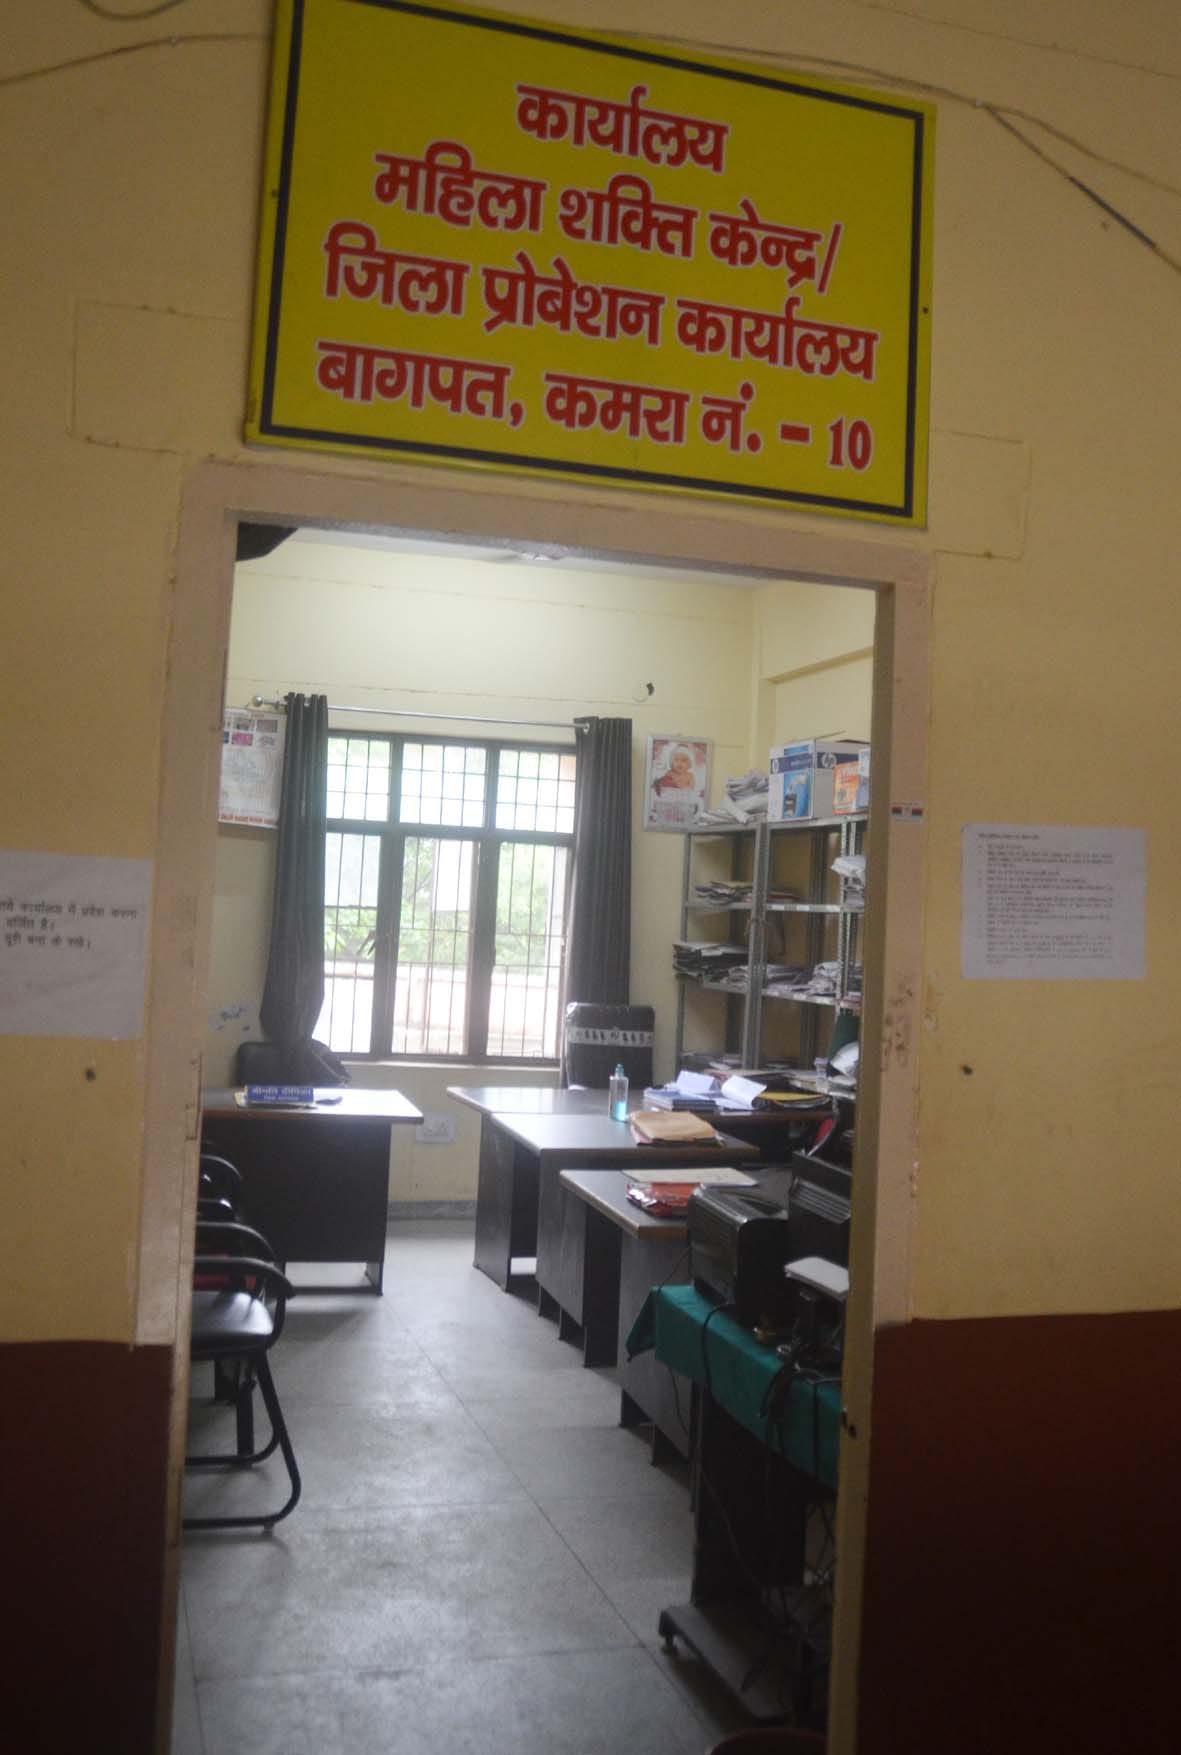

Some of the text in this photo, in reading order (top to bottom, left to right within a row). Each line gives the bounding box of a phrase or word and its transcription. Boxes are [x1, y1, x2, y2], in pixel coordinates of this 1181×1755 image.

[516, 84, 730, 173] कार्यालय
[374, 139, 546, 231] महिला
[559, 174, 699, 257] शक्ति
[324, 221, 878, 380] जिला प्रोबेशन कार्यालय
[317, 340, 523, 426] बागपत,
[544, 372, 690, 443] कमरा
[701, 382, 761, 453] नं.
[829, 419, 873, 471] 10
